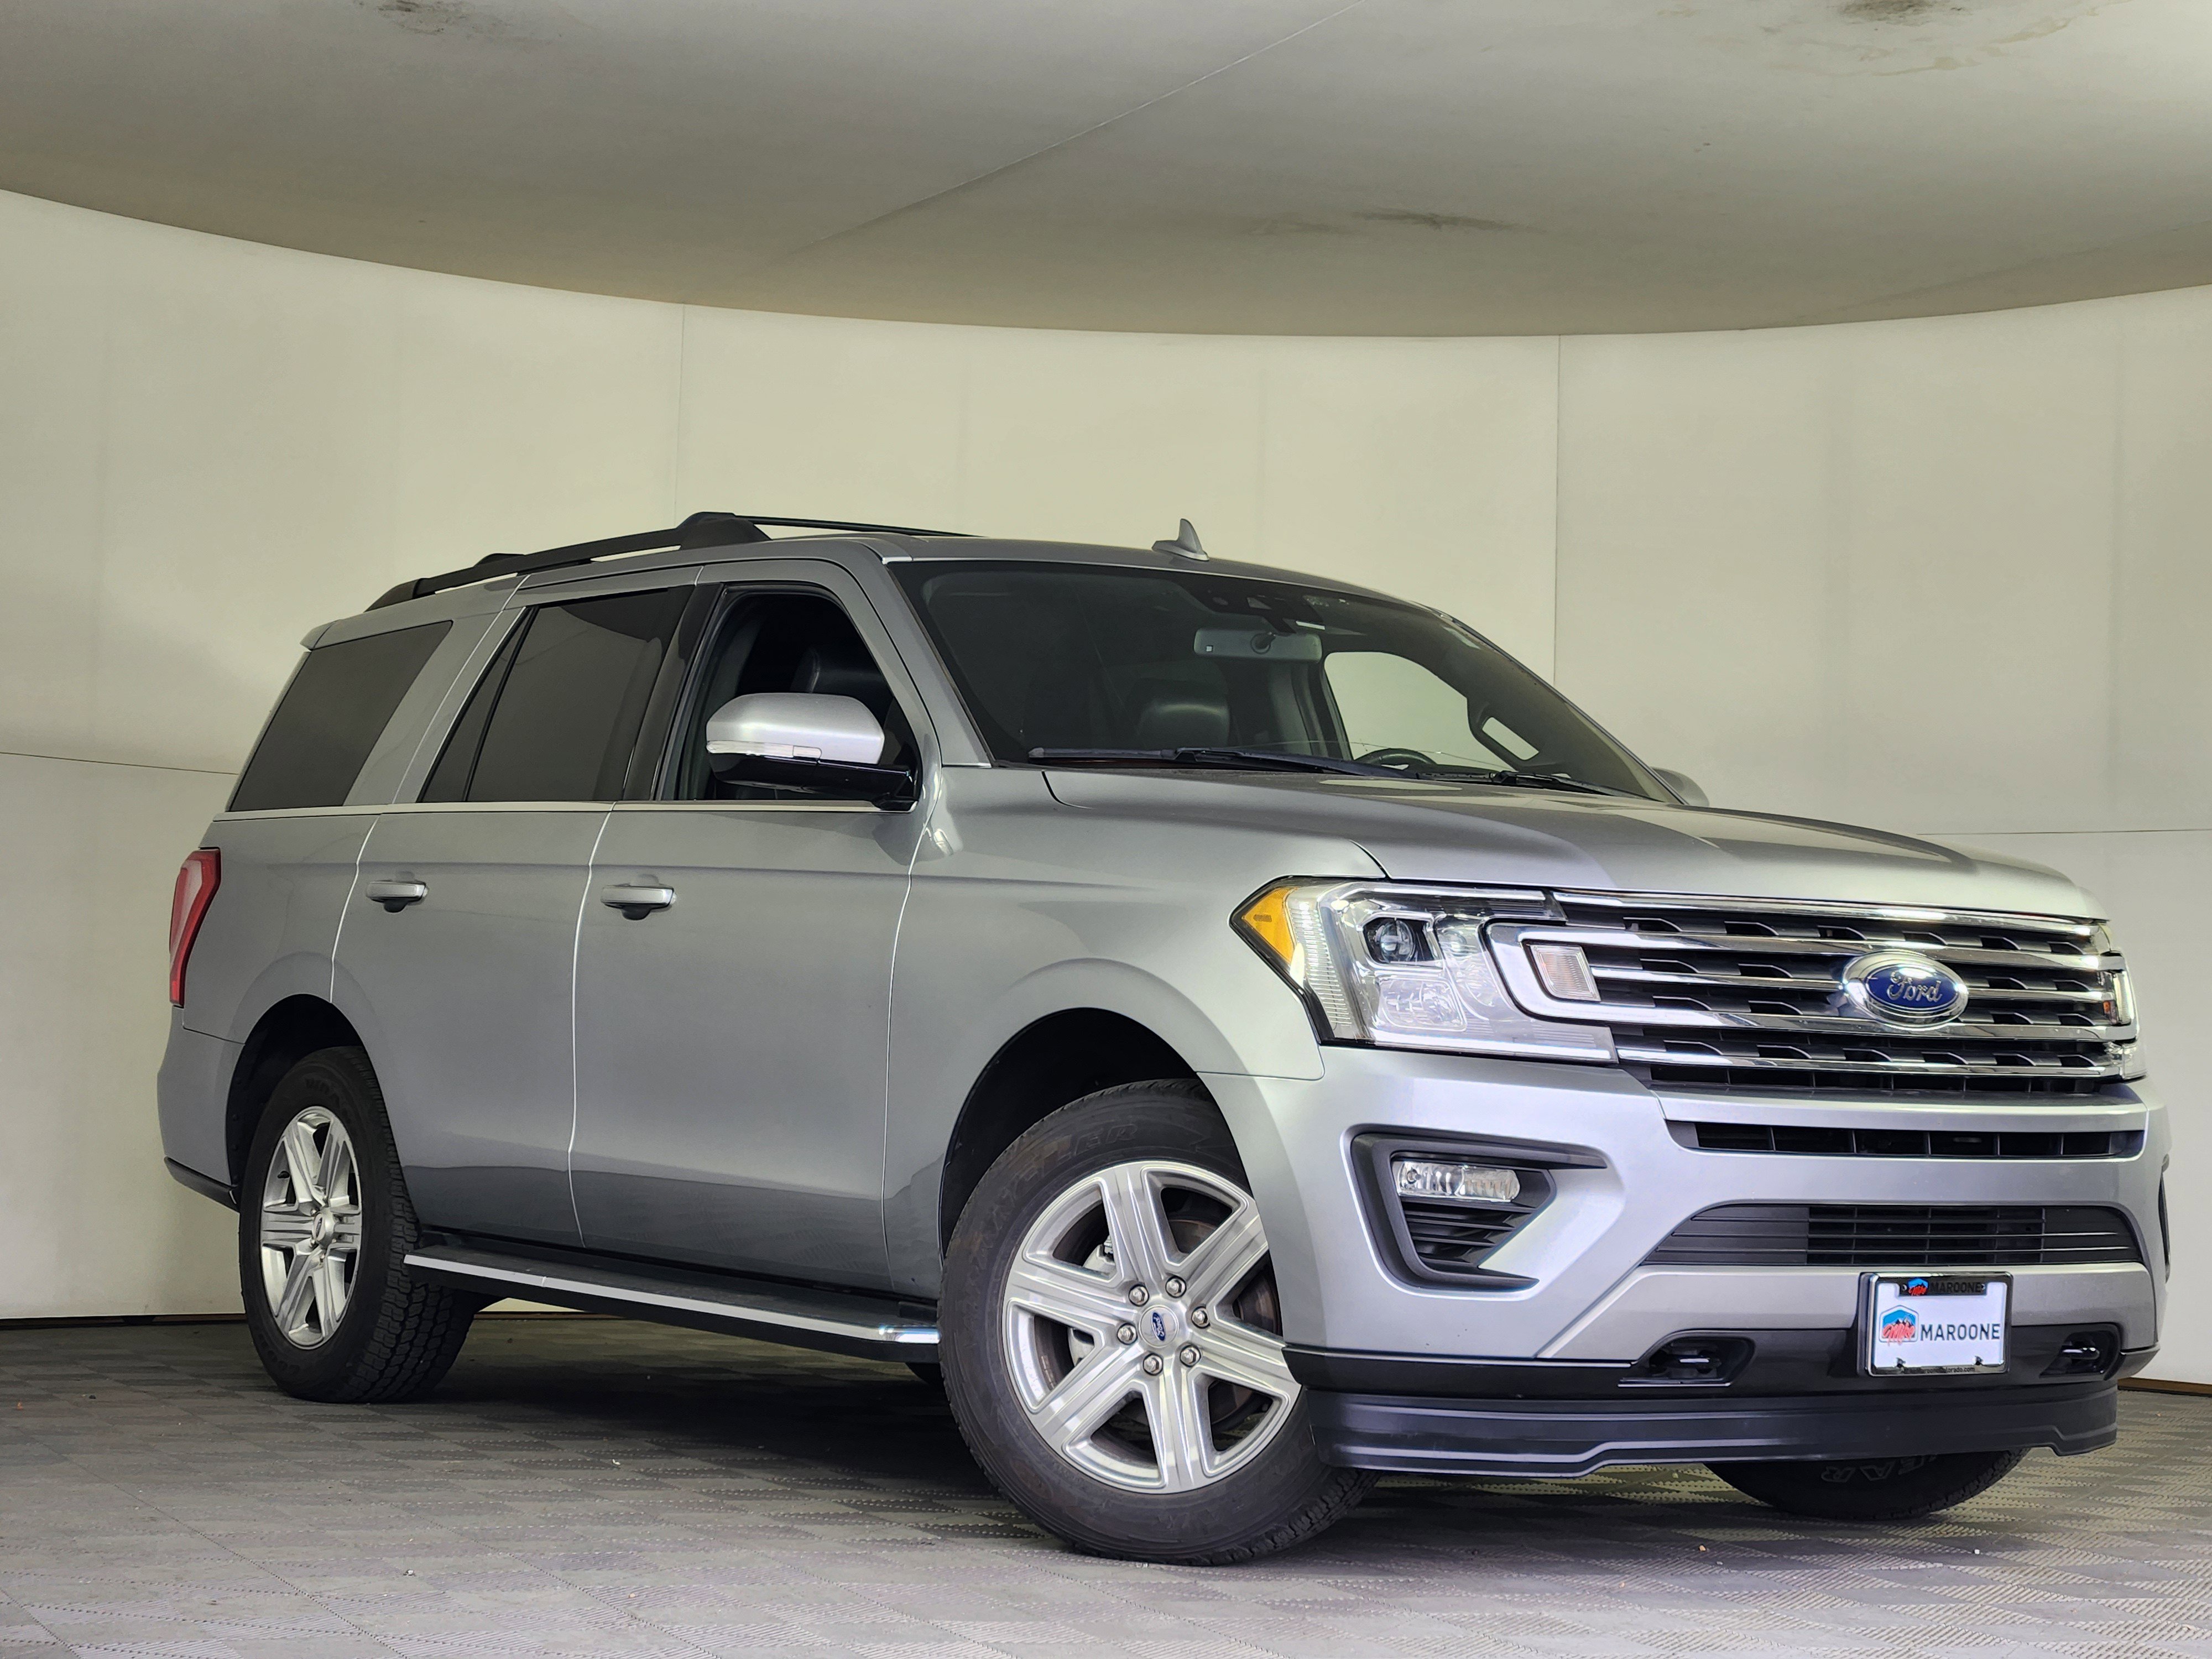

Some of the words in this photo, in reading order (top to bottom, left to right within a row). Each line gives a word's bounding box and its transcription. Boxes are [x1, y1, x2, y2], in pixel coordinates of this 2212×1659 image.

[1886, 971, 1942, 1002] Ford
[1931, 1281, 1981, 1292] MAROONE
[1920, 1323, 2000, 1340] MAROONE
